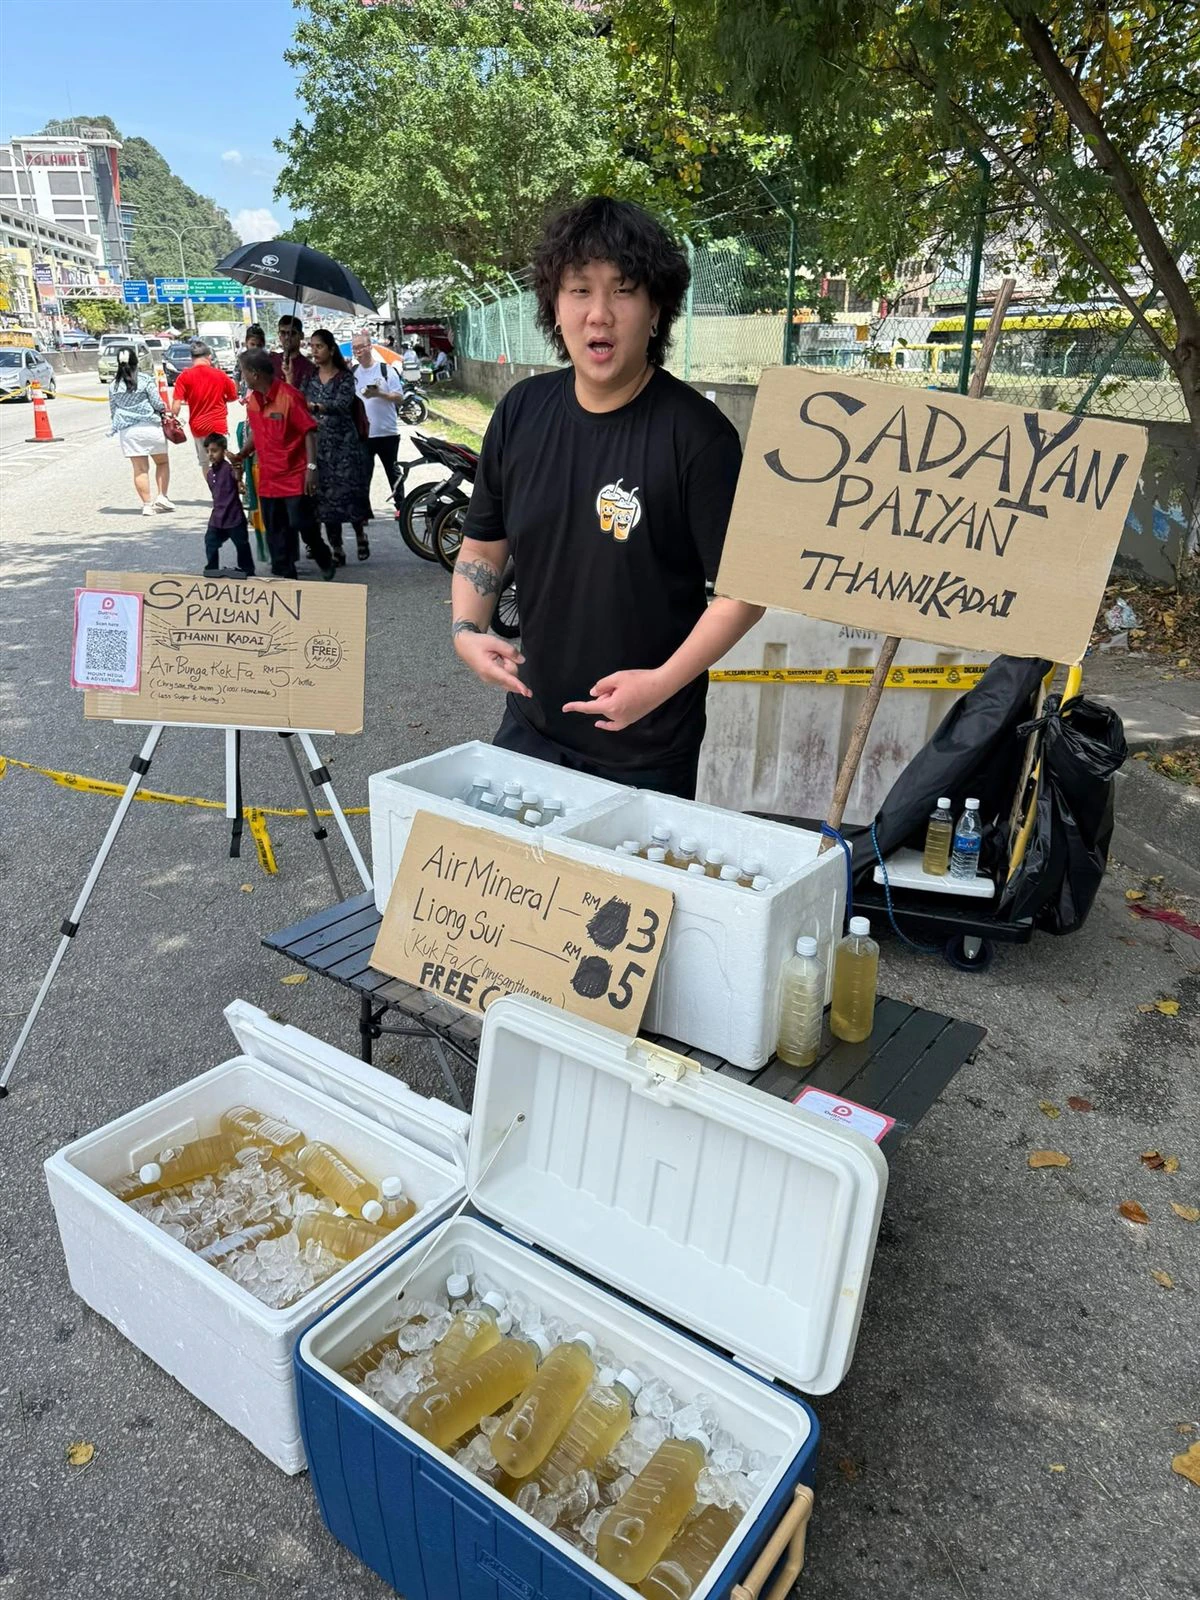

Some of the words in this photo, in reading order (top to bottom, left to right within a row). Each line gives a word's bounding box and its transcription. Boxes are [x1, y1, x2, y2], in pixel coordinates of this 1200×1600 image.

[764, 391, 1129, 518] SADAYAN
[827, 475, 1019, 557] PAIYAN
[143, 580, 302, 621] SADAIYAN
[186, 604, 260, 626] PAIYAN
[172, 631, 219, 643] THANNI
[226, 632, 264, 646] KADAI
[312, 645, 337, 657] FREE
[176, 655, 208, 682] Bunga
[236, 661, 255, 681] Fa
[421, 845, 467, 882] Air
[464, 856, 561, 921] Mineral
[582, 891, 601, 911] RM
[625, 908, 660, 954] 3
[413, 887, 466, 941] Liong
[470, 910, 506, 947] Sui
[562, 940, 582, 960] RM
[608, 961, 646, 1010] 5
[419, 961, 478, 1005] FREE
